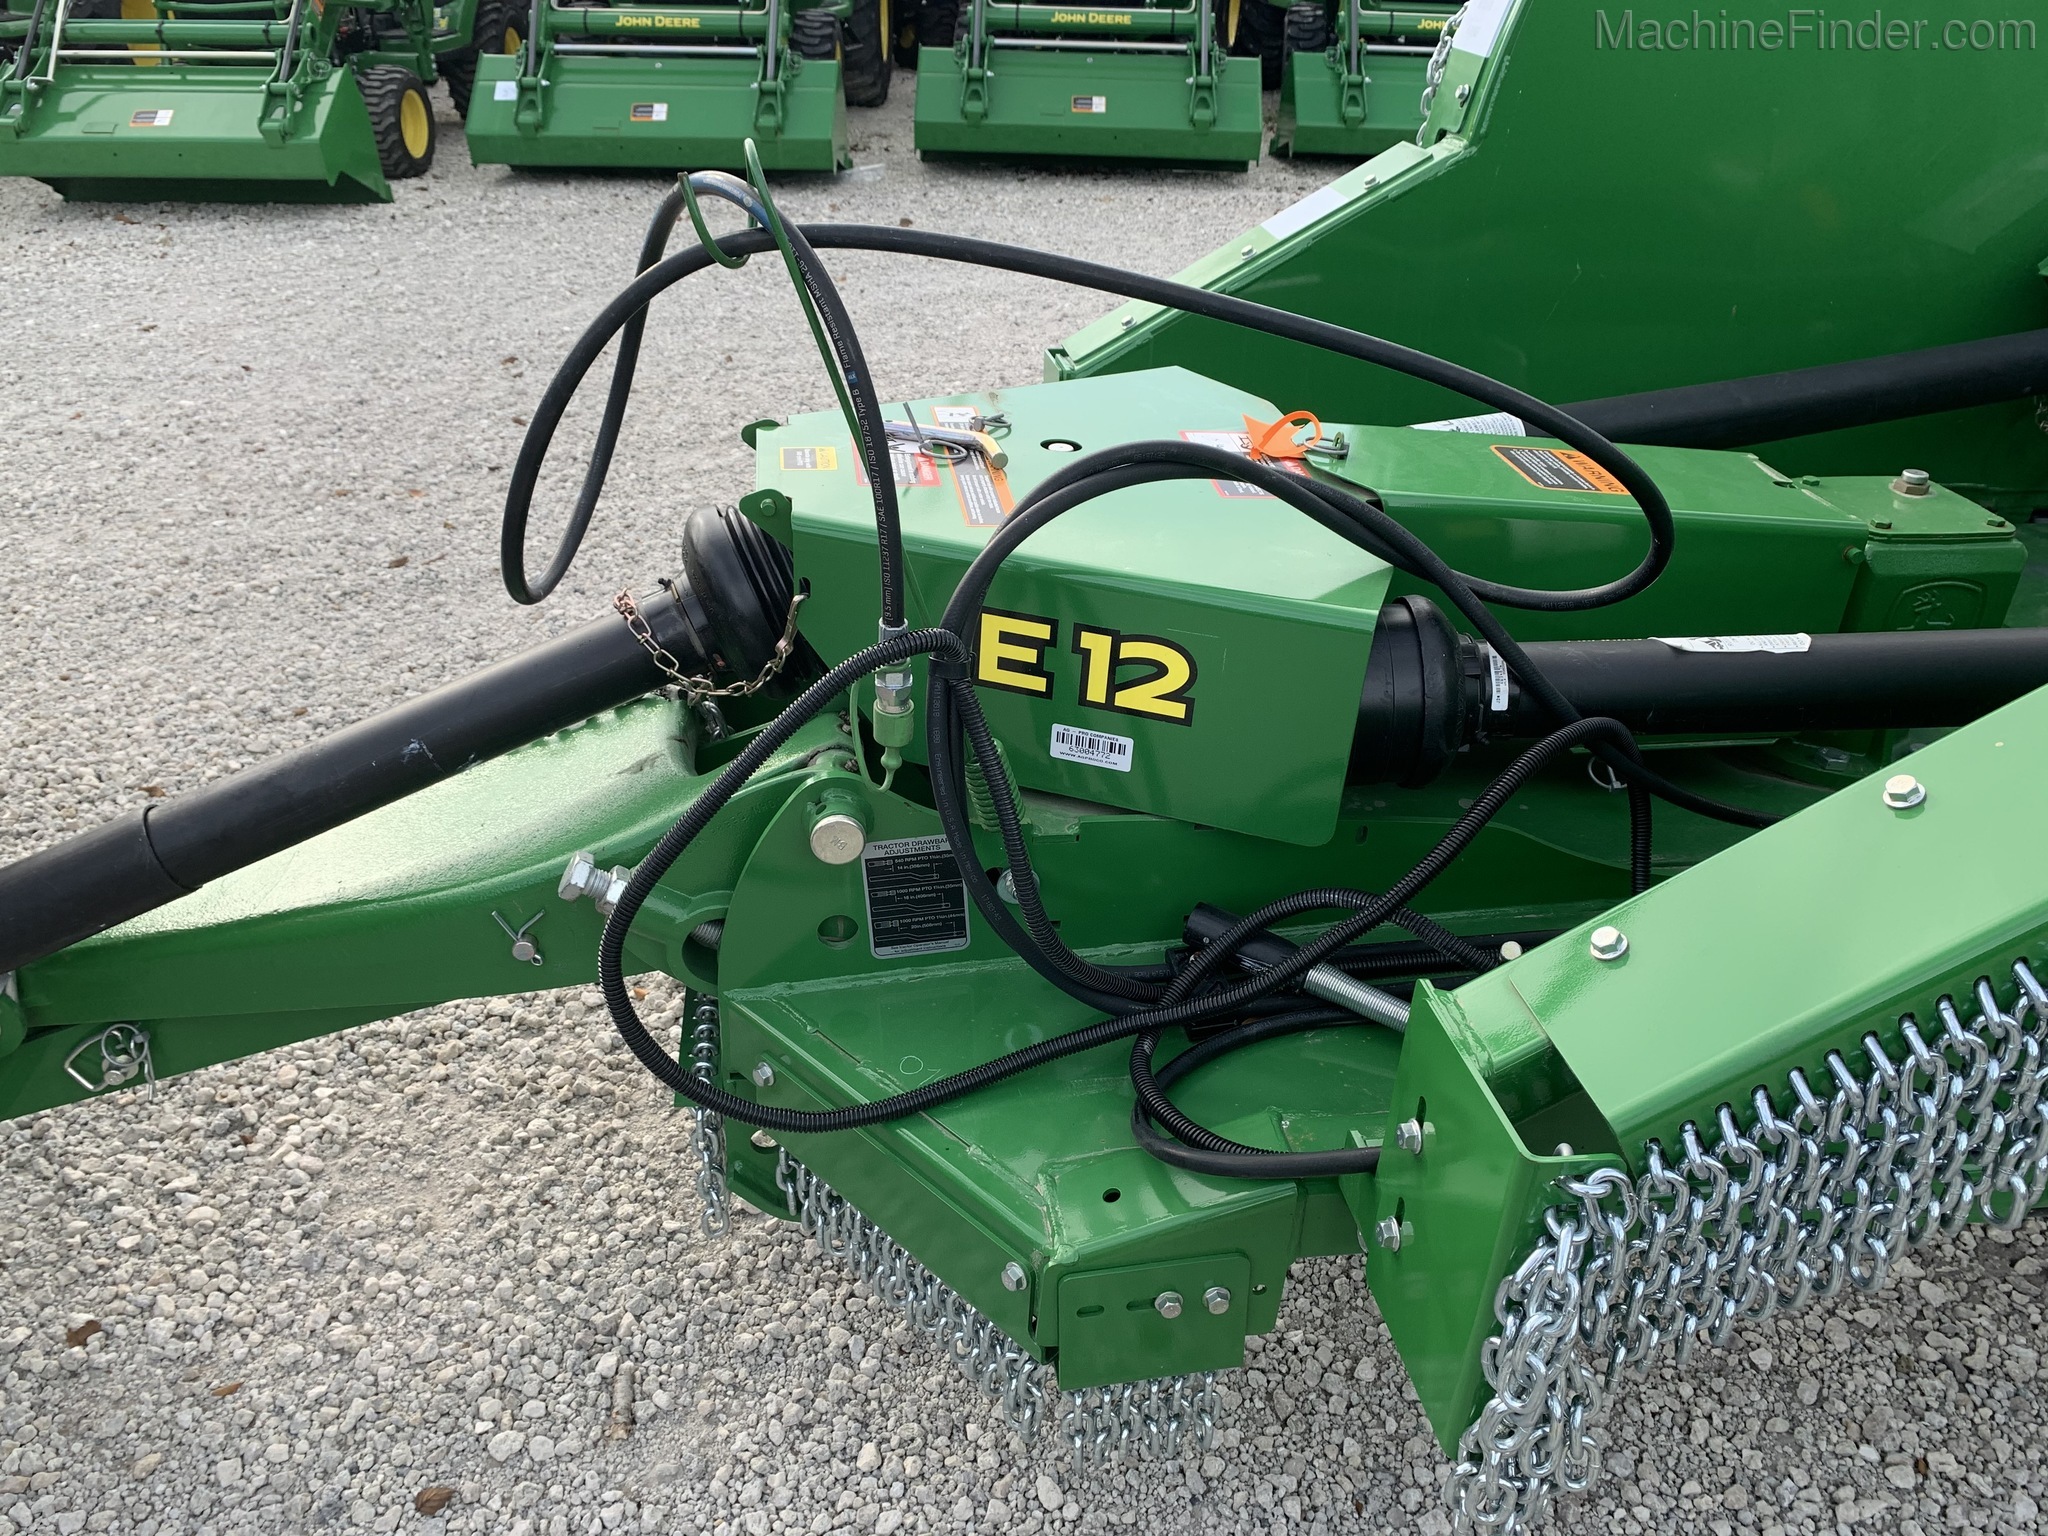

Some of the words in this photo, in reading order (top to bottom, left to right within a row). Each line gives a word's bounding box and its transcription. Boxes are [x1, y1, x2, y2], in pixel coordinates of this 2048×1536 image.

[615, 15, 652, 27] JOHN
[654, 15, 700, 28] DEERE
[1051, 11, 1086, 23] JOHN
[1088, 12, 1132, 25] DEERE
[818, 297, 841, 340] Resistant
[837, 340, 851, 369] Flame
[976, 611, 1055, 695] E
[1077, 628, 1192, 721] 12
[1089, 732, 1119, 742] COMPANIES
[873, 840, 910, 851] TRACTOR
[884, 845, 941, 856] ADJUSTMENTS
